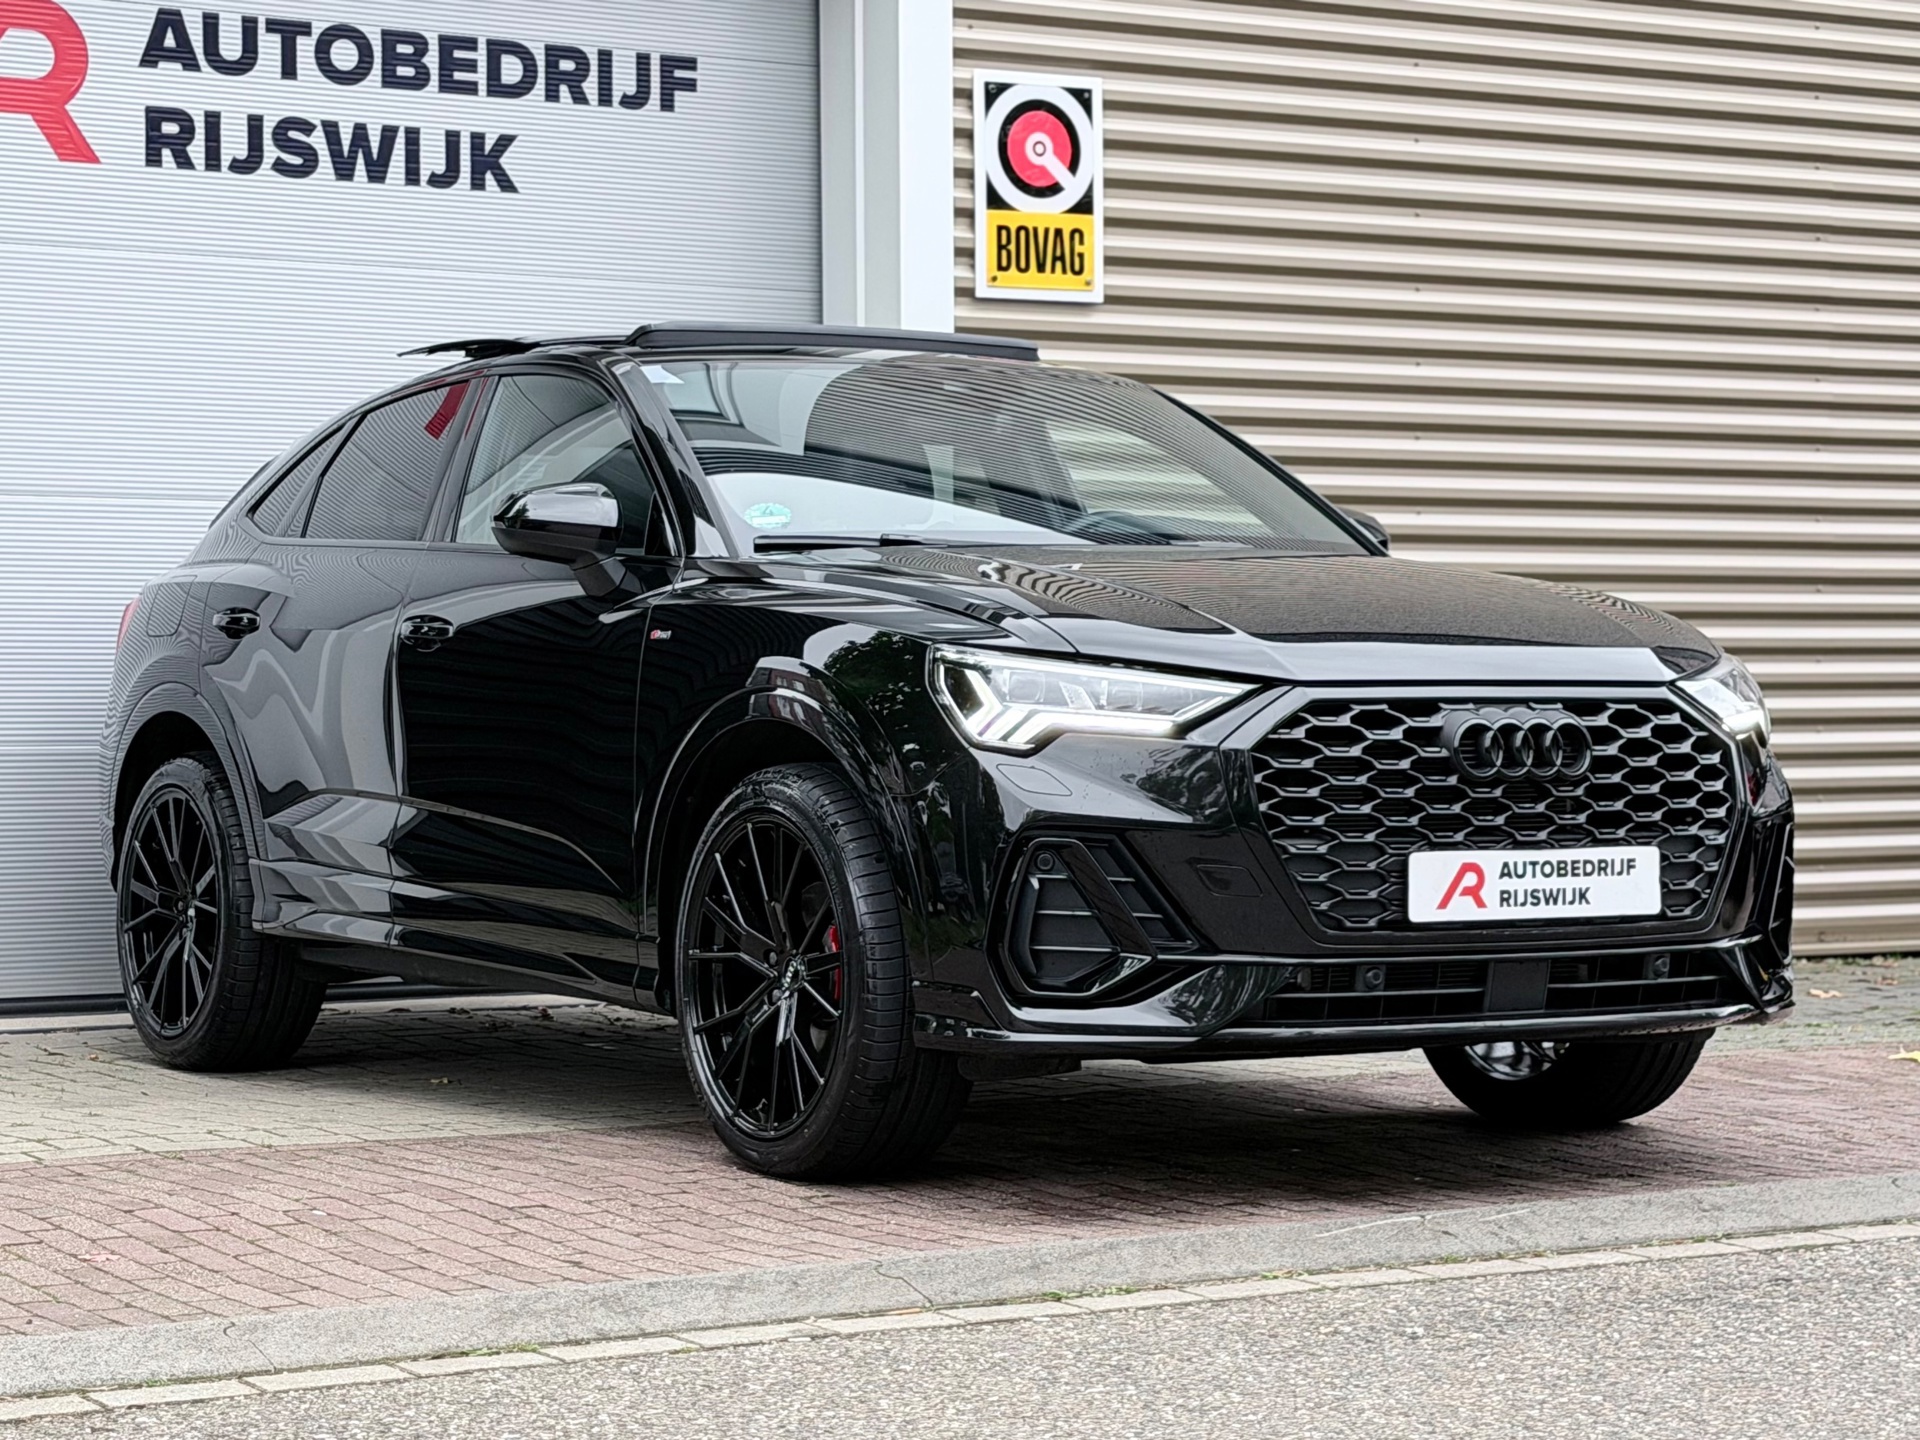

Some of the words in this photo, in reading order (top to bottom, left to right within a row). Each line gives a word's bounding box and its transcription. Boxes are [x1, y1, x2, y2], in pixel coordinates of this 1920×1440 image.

[138, 7, 698, 112] AUTOBEDRIJF
[144, 105, 519, 193] RIJSWIJK
[996, 224, 1085, 276] BOVAG
[1498, 858, 1637, 880] AUTOBEDRIJF
[1499, 887, 1592, 908] RIJSWIJK
